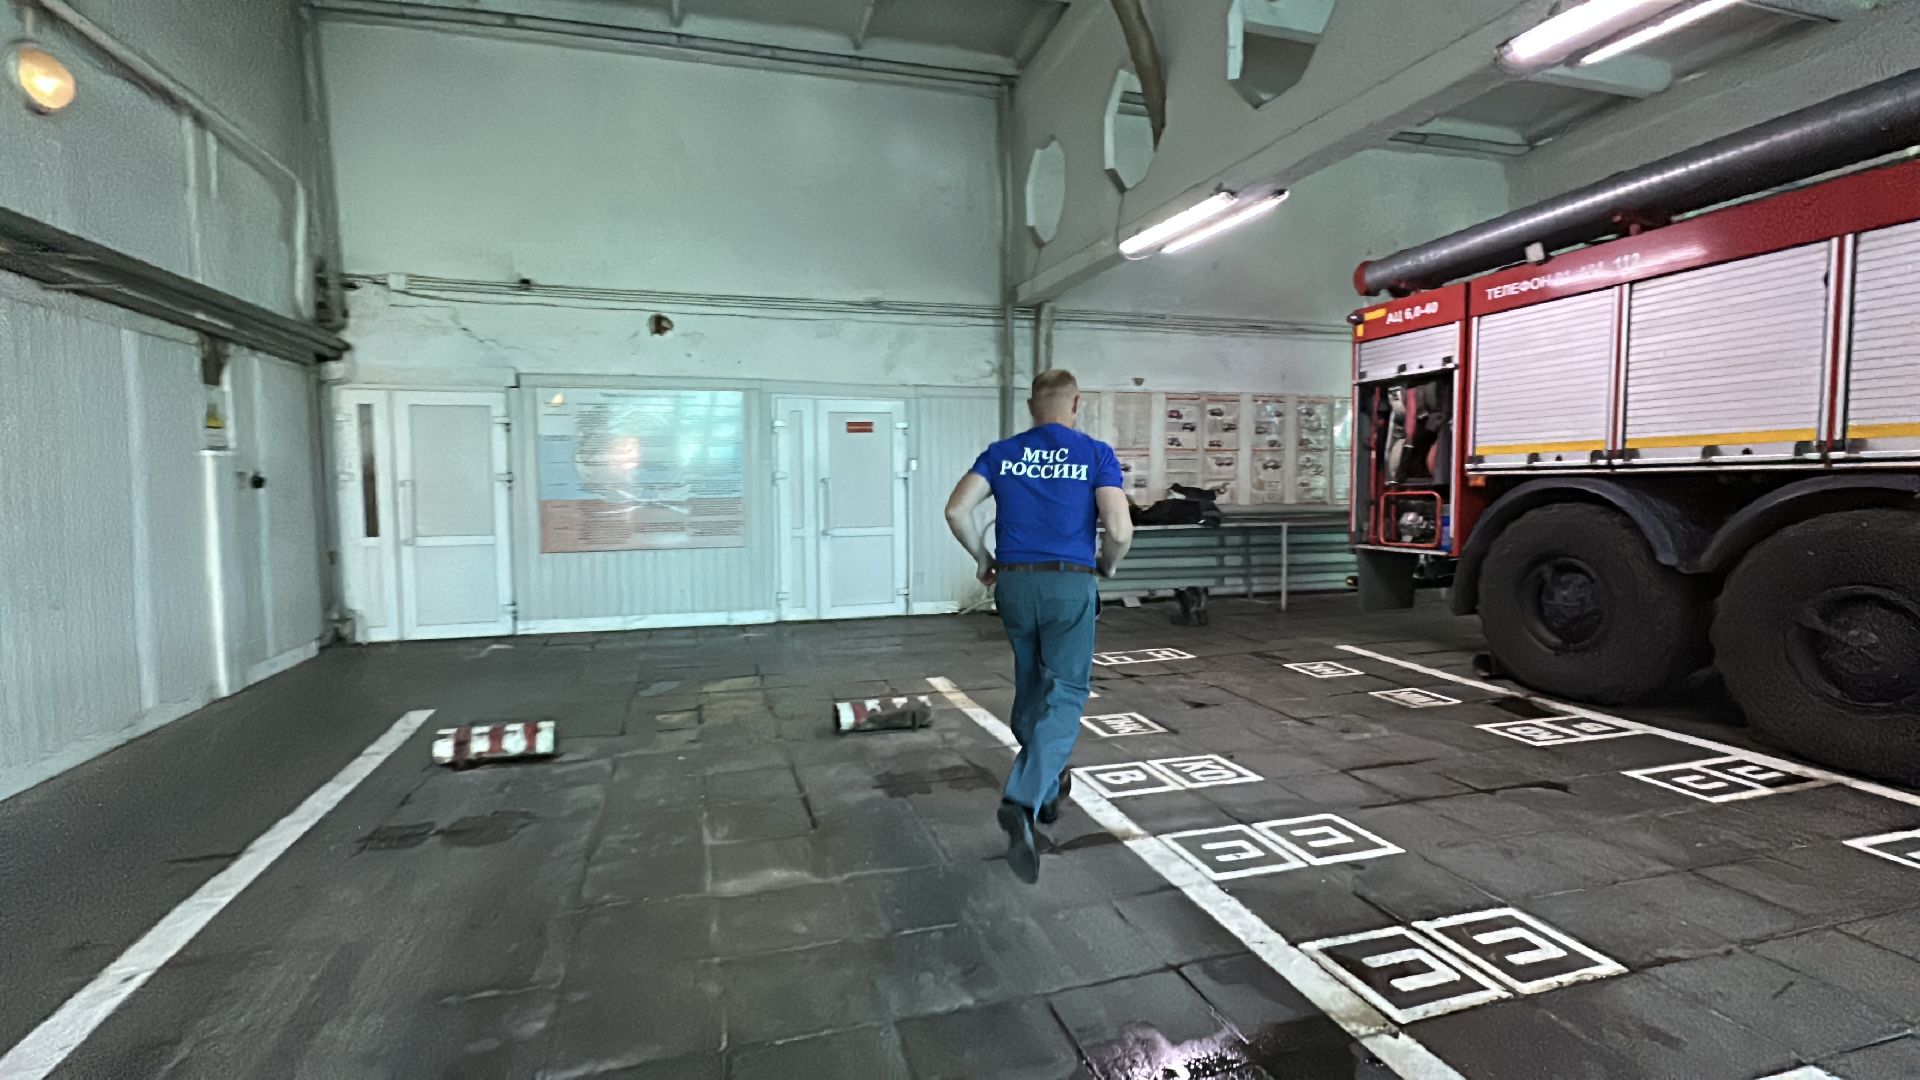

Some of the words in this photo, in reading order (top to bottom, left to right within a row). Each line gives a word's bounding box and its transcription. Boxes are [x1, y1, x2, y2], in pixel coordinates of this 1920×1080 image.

[1484, 273, 1552, 300] ТЕЛЕФОН
[1385, 309, 1404, 325] АЦ
[1021, 446, 1069, 464] МЧС
[999, 459, 1089, 481] РОССИИ
[1095, 769, 1148, 784] В
[1173, 759, 1238, 782] КО
